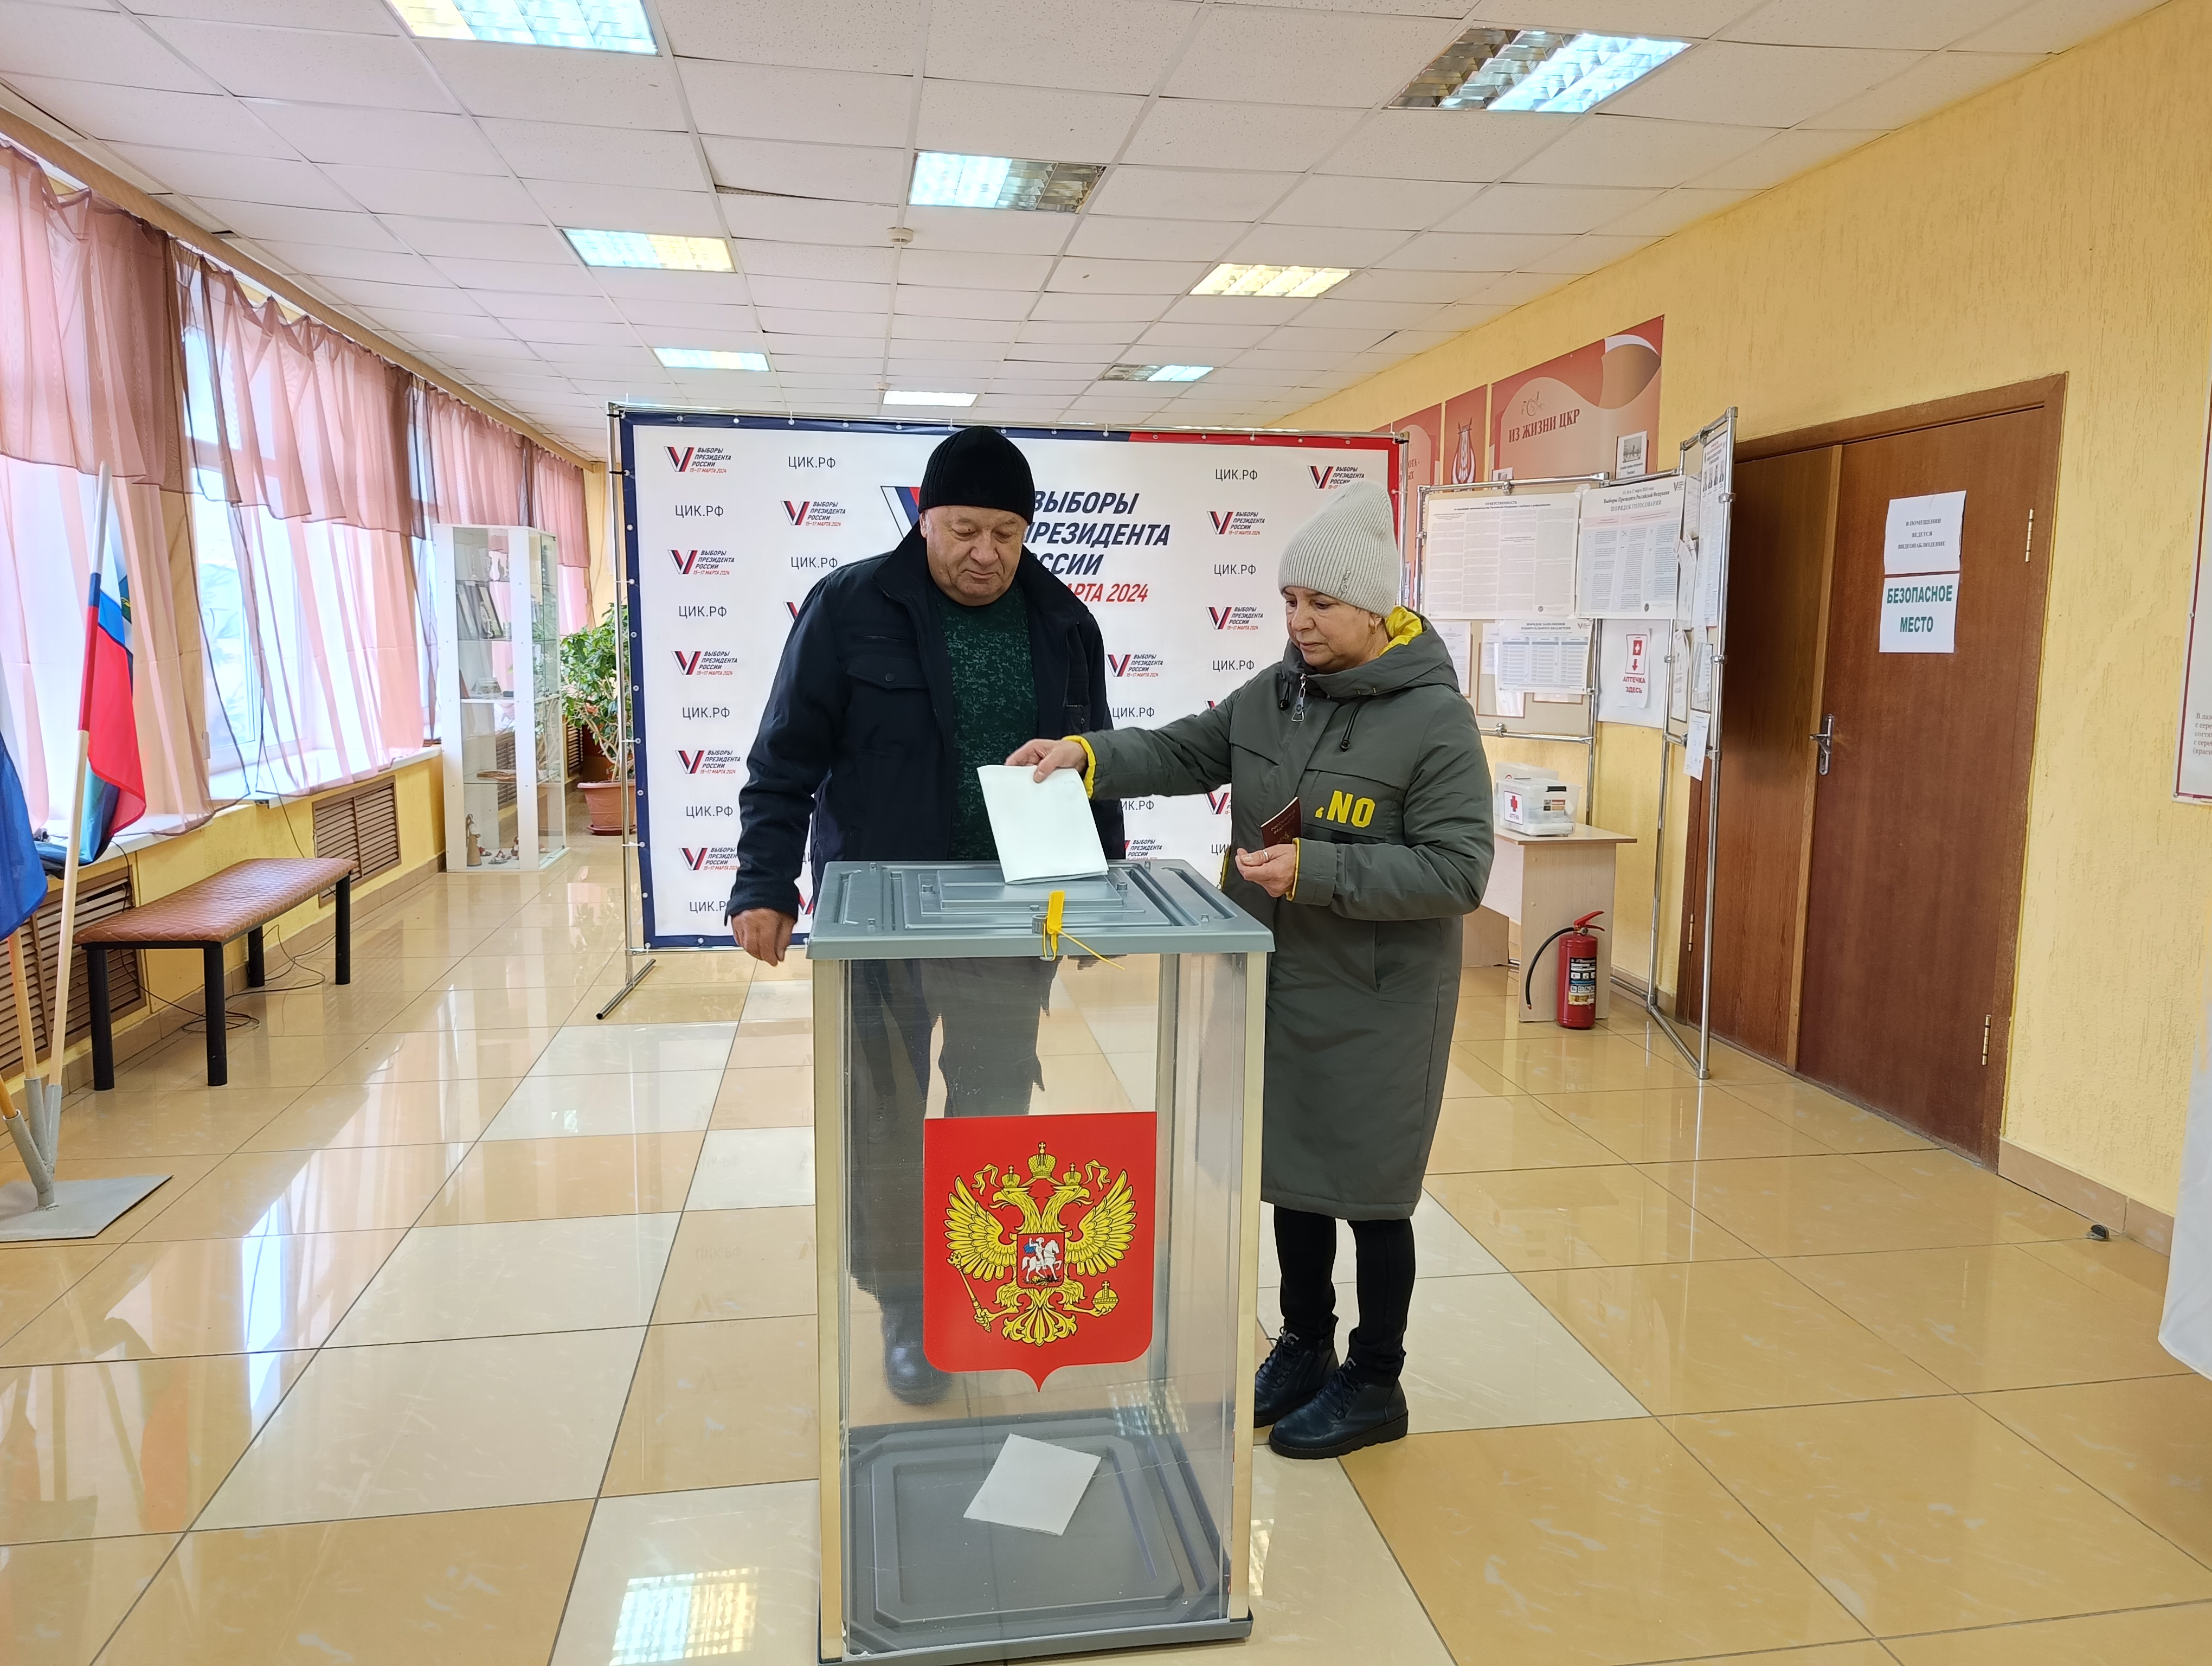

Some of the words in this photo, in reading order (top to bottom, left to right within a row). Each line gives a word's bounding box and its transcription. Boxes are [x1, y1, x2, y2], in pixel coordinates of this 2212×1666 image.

[1509, 427, 1520, 443] ИЗ
[1522, 415, 1557, 439] ЖИЗНИ
[1559, 409, 1580, 430] ЦКР
[789, 457, 835, 469] ЦИК.РФ
[1216, 469, 1257, 481] ЦИК.РФ
[1034, 491, 1140, 514] ВЫБОРЫ
[676, 505, 723, 518] ЦИК.РФ
[791, 557, 838, 569] ЦИК.РФ
[1214, 565, 1256, 576] ЦИК.РФ
[1106, 584, 1148, 602] 2024
[1887, 585, 1952, 604] БЕЗОПАСНОЕ
[679, 606, 726, 619] ЦИК.РФ
[1900, 616, 1933, 632] МЕСТО
[1213, 660, 1254, 672] ЦИК.РФ
[683, 707, 730, 720] ЦИК.РФ
[1113, 707, 1154, 720] ЦИК.РФ
[1121, 800, 1154, 810] ИК.РФ
[686, 806, 732, 818] ЦИК.РФ
[690, 901, 726, 913] ЦИК.Р
